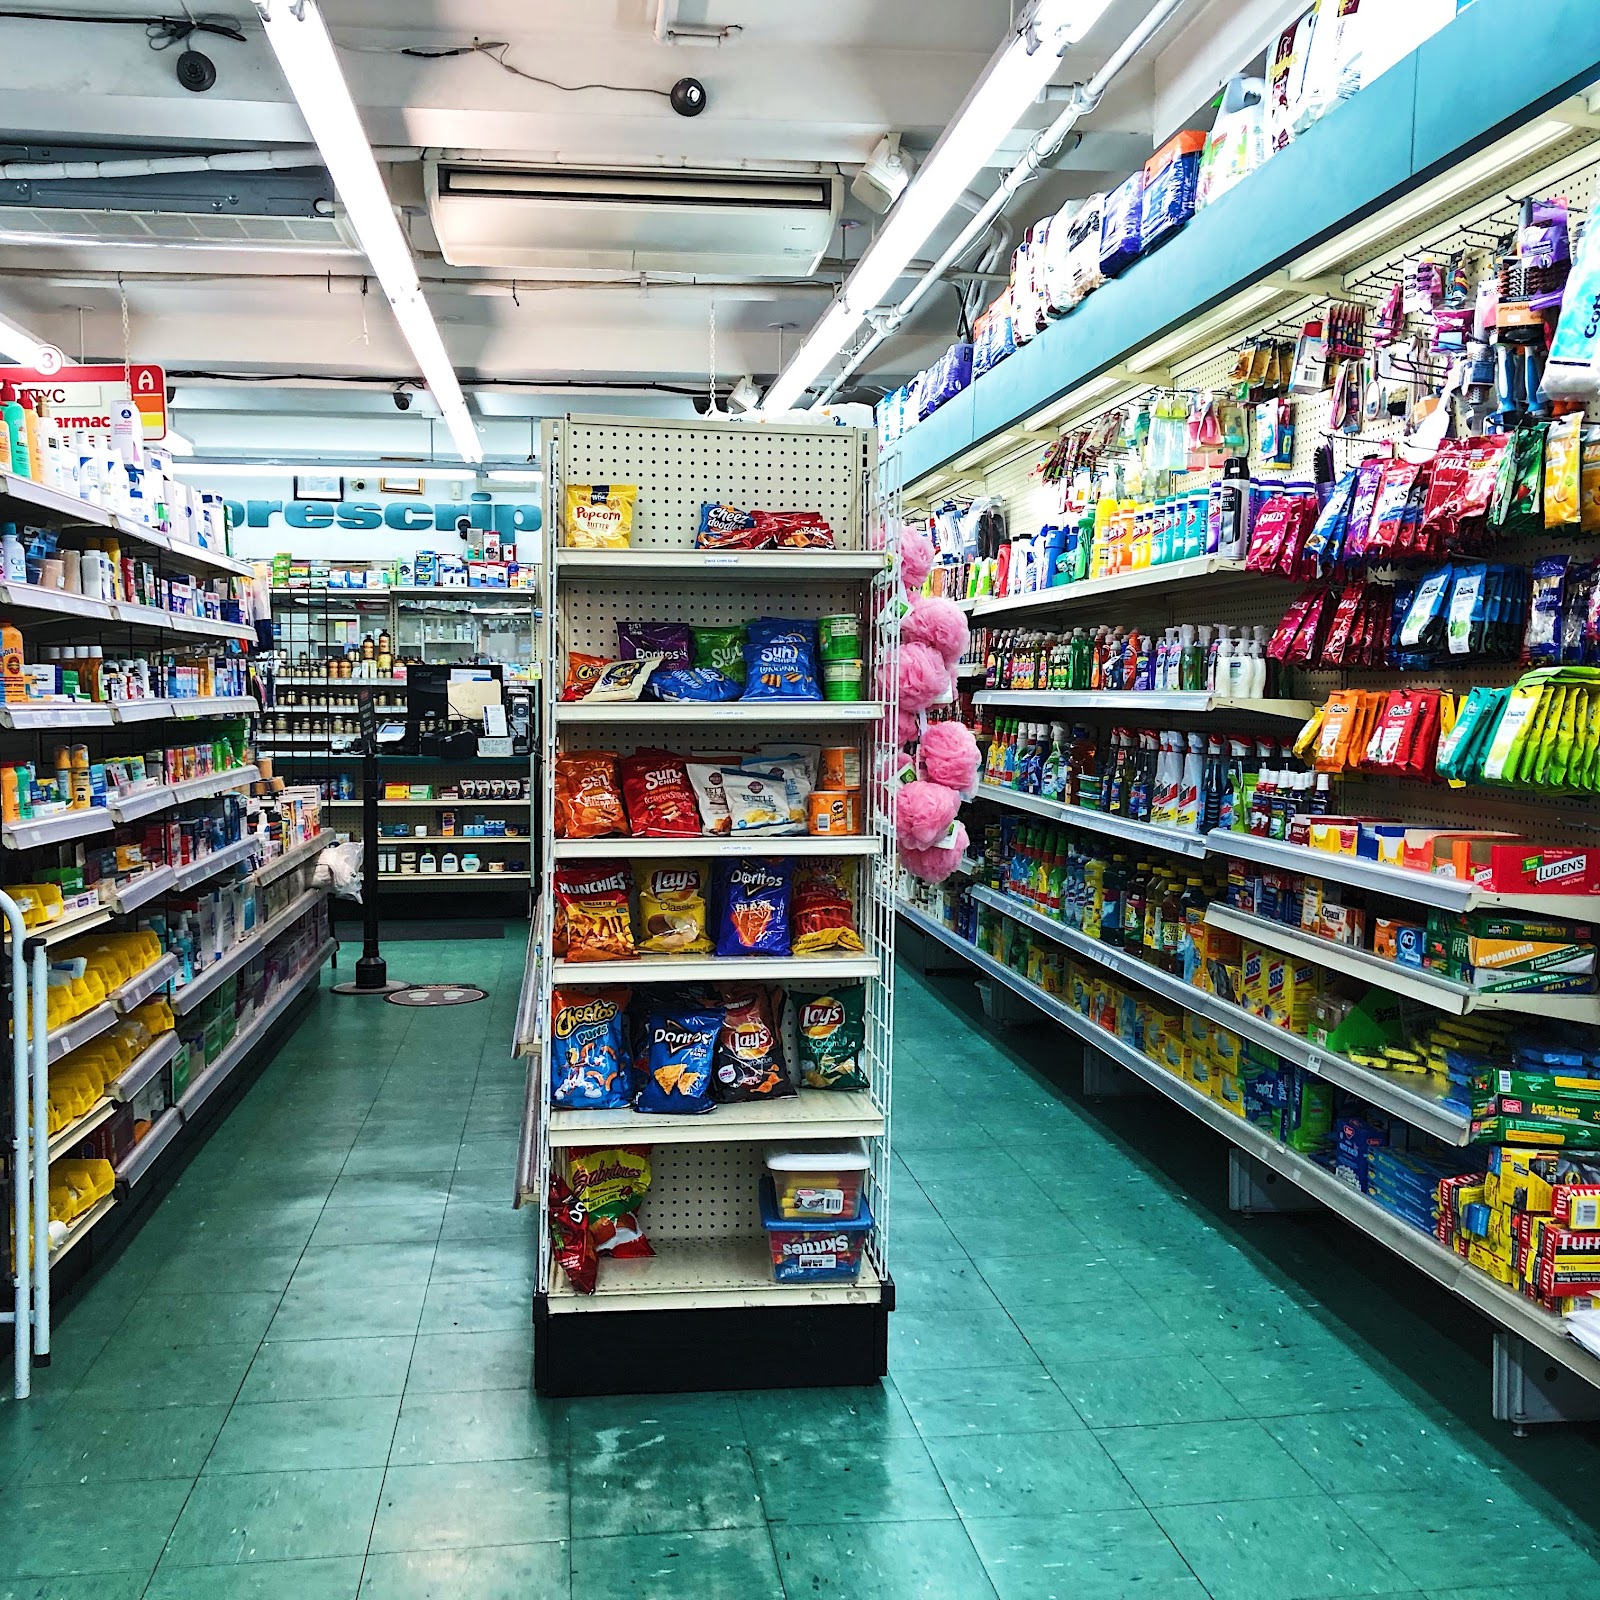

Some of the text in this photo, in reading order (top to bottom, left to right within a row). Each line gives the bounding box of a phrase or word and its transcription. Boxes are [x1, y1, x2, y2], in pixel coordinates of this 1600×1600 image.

[42, 352, 53, 368] 3
[138, 369, 154, 391] A
[576, 507, 621, 521] Popcorn
[708, 507, 750, 524] Cheez
[587, 521, 610, 530] BUTTER
[635, 647, 680, 661] Doritos
[760, 646, 799, 662] Sun
[773, 656, 797, 664] CHIPS
[481, 740, 508, 748] NOTARY
[482, 747, 508, 755] PUBLIC
[644, 768, 683, 791] Sun
[658, 778, 682, 786] CHIPS
[730, 869, 784, 888] Doritos
[1539, 858, 1584, 881] LUDEN'S
[557, 872, 627, 895] MUNCHIES
[660, 901, 696, 912] Classic
[1400, 933, 1416, 947] ACT
[1478, 943, 1534, 967] SPARKLING
[555, 999, 618, 1039] Cheetos
[803, 1005, 842, 1028] Lay's
[654, 1028, 713, 1045] Doritos
[734, 1030, 769, 1052] Lay's
[572, 1160, 643, 1191] Sabritones
[1521, 1214, 1529, 1240] TUFF
[782, 1234, 849, 1256] Skittles
[1546, 1232, 1555, 1260] TUFF
[1519, 1247, 1528, 1274] TUFF
[1542, 1263, 1551, 1291] TUFF
